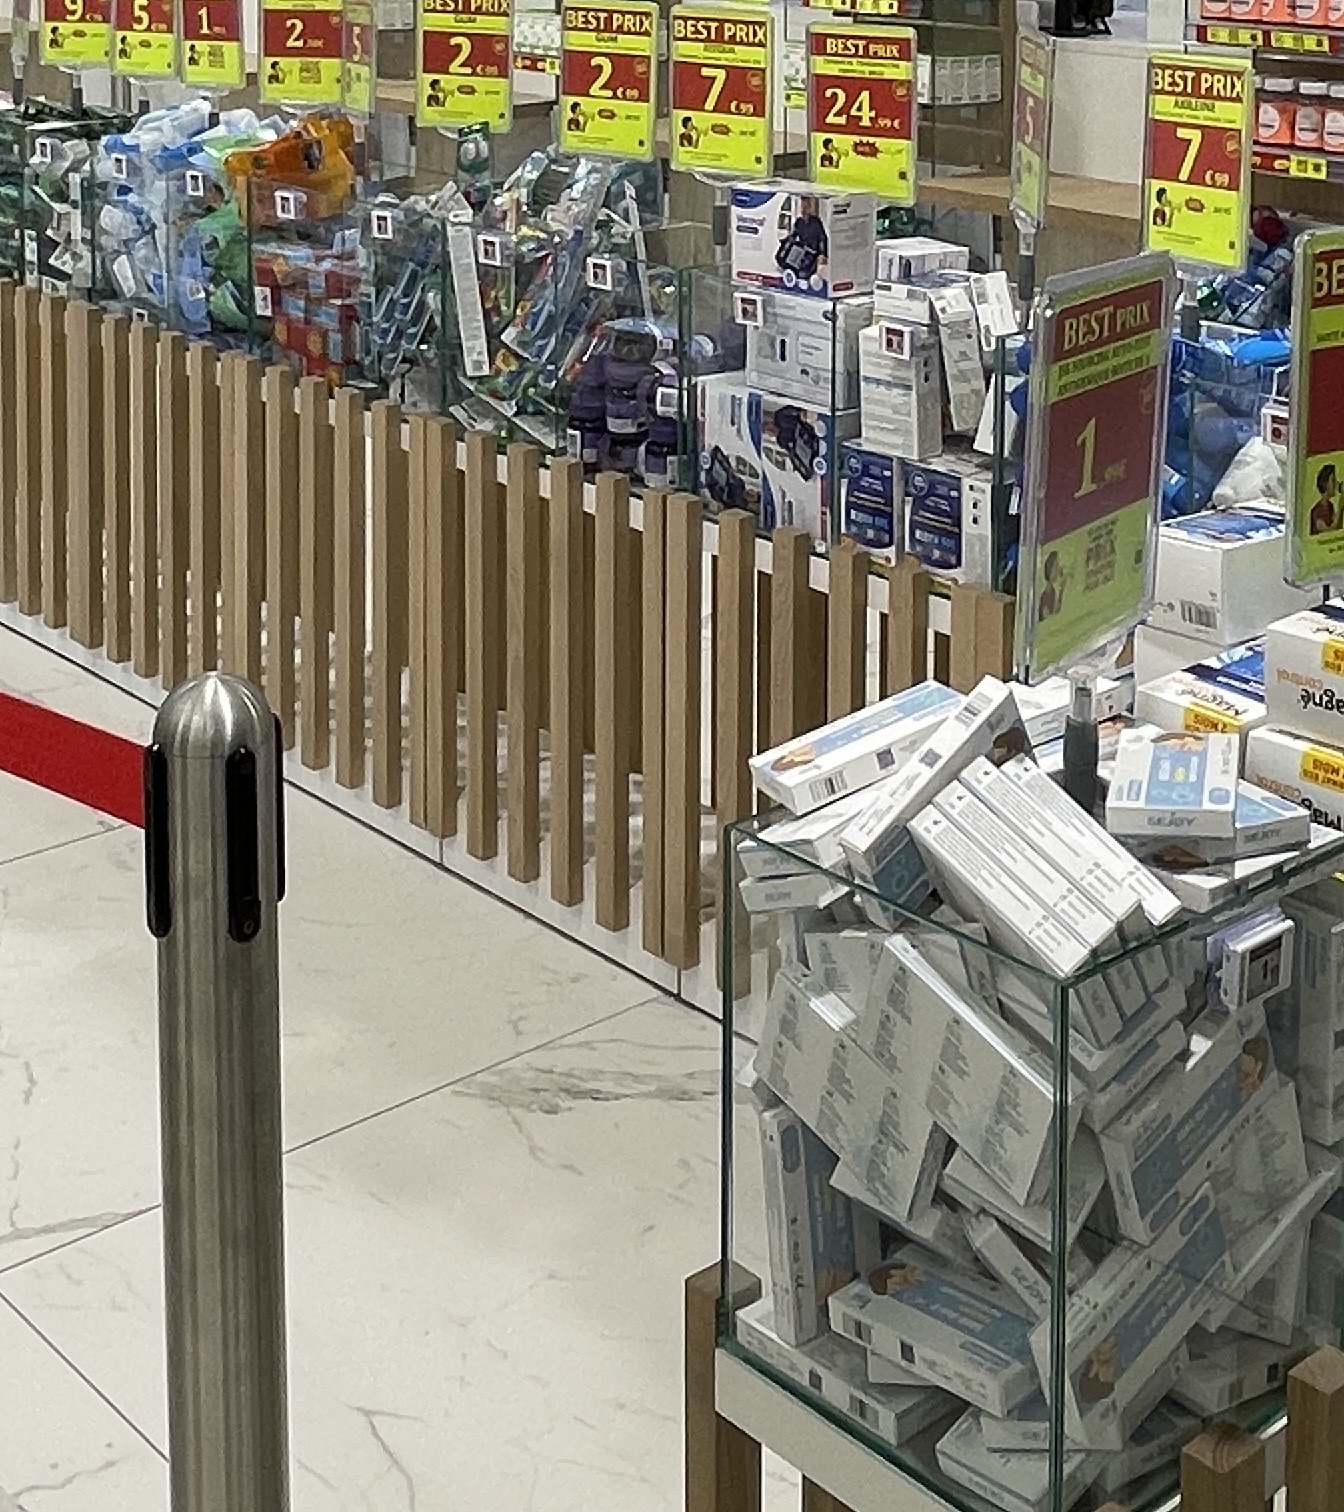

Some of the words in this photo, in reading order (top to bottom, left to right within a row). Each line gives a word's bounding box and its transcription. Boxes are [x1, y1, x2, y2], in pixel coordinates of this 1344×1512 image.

[197, 6, 212, 34] 1
[285, 18, 304, 48] 2
[566, 10, 609, 29] BEST
[612, 12, 653, 32] PRIX
[673, 19, 720, 40] BEST
[723, 21, 767, 43] PRIX
[448, 35, 474, 76] 2
[825, 37, 867, 55] BEST
[588, 56, 615, 97] 2
[700, 66, 728, 112] 7
[1152, 68, 1196, 94] BEST
[1200, 72, 1244, 98] PRIX
[824, 87, 876, 128] 24
[1176, 127, 1202, 182] 7
[1062, 304, 1115, 352] BEST
[1116, 299, 1152, 334] PRIX
[1072, 417, 1098, 500] 1
